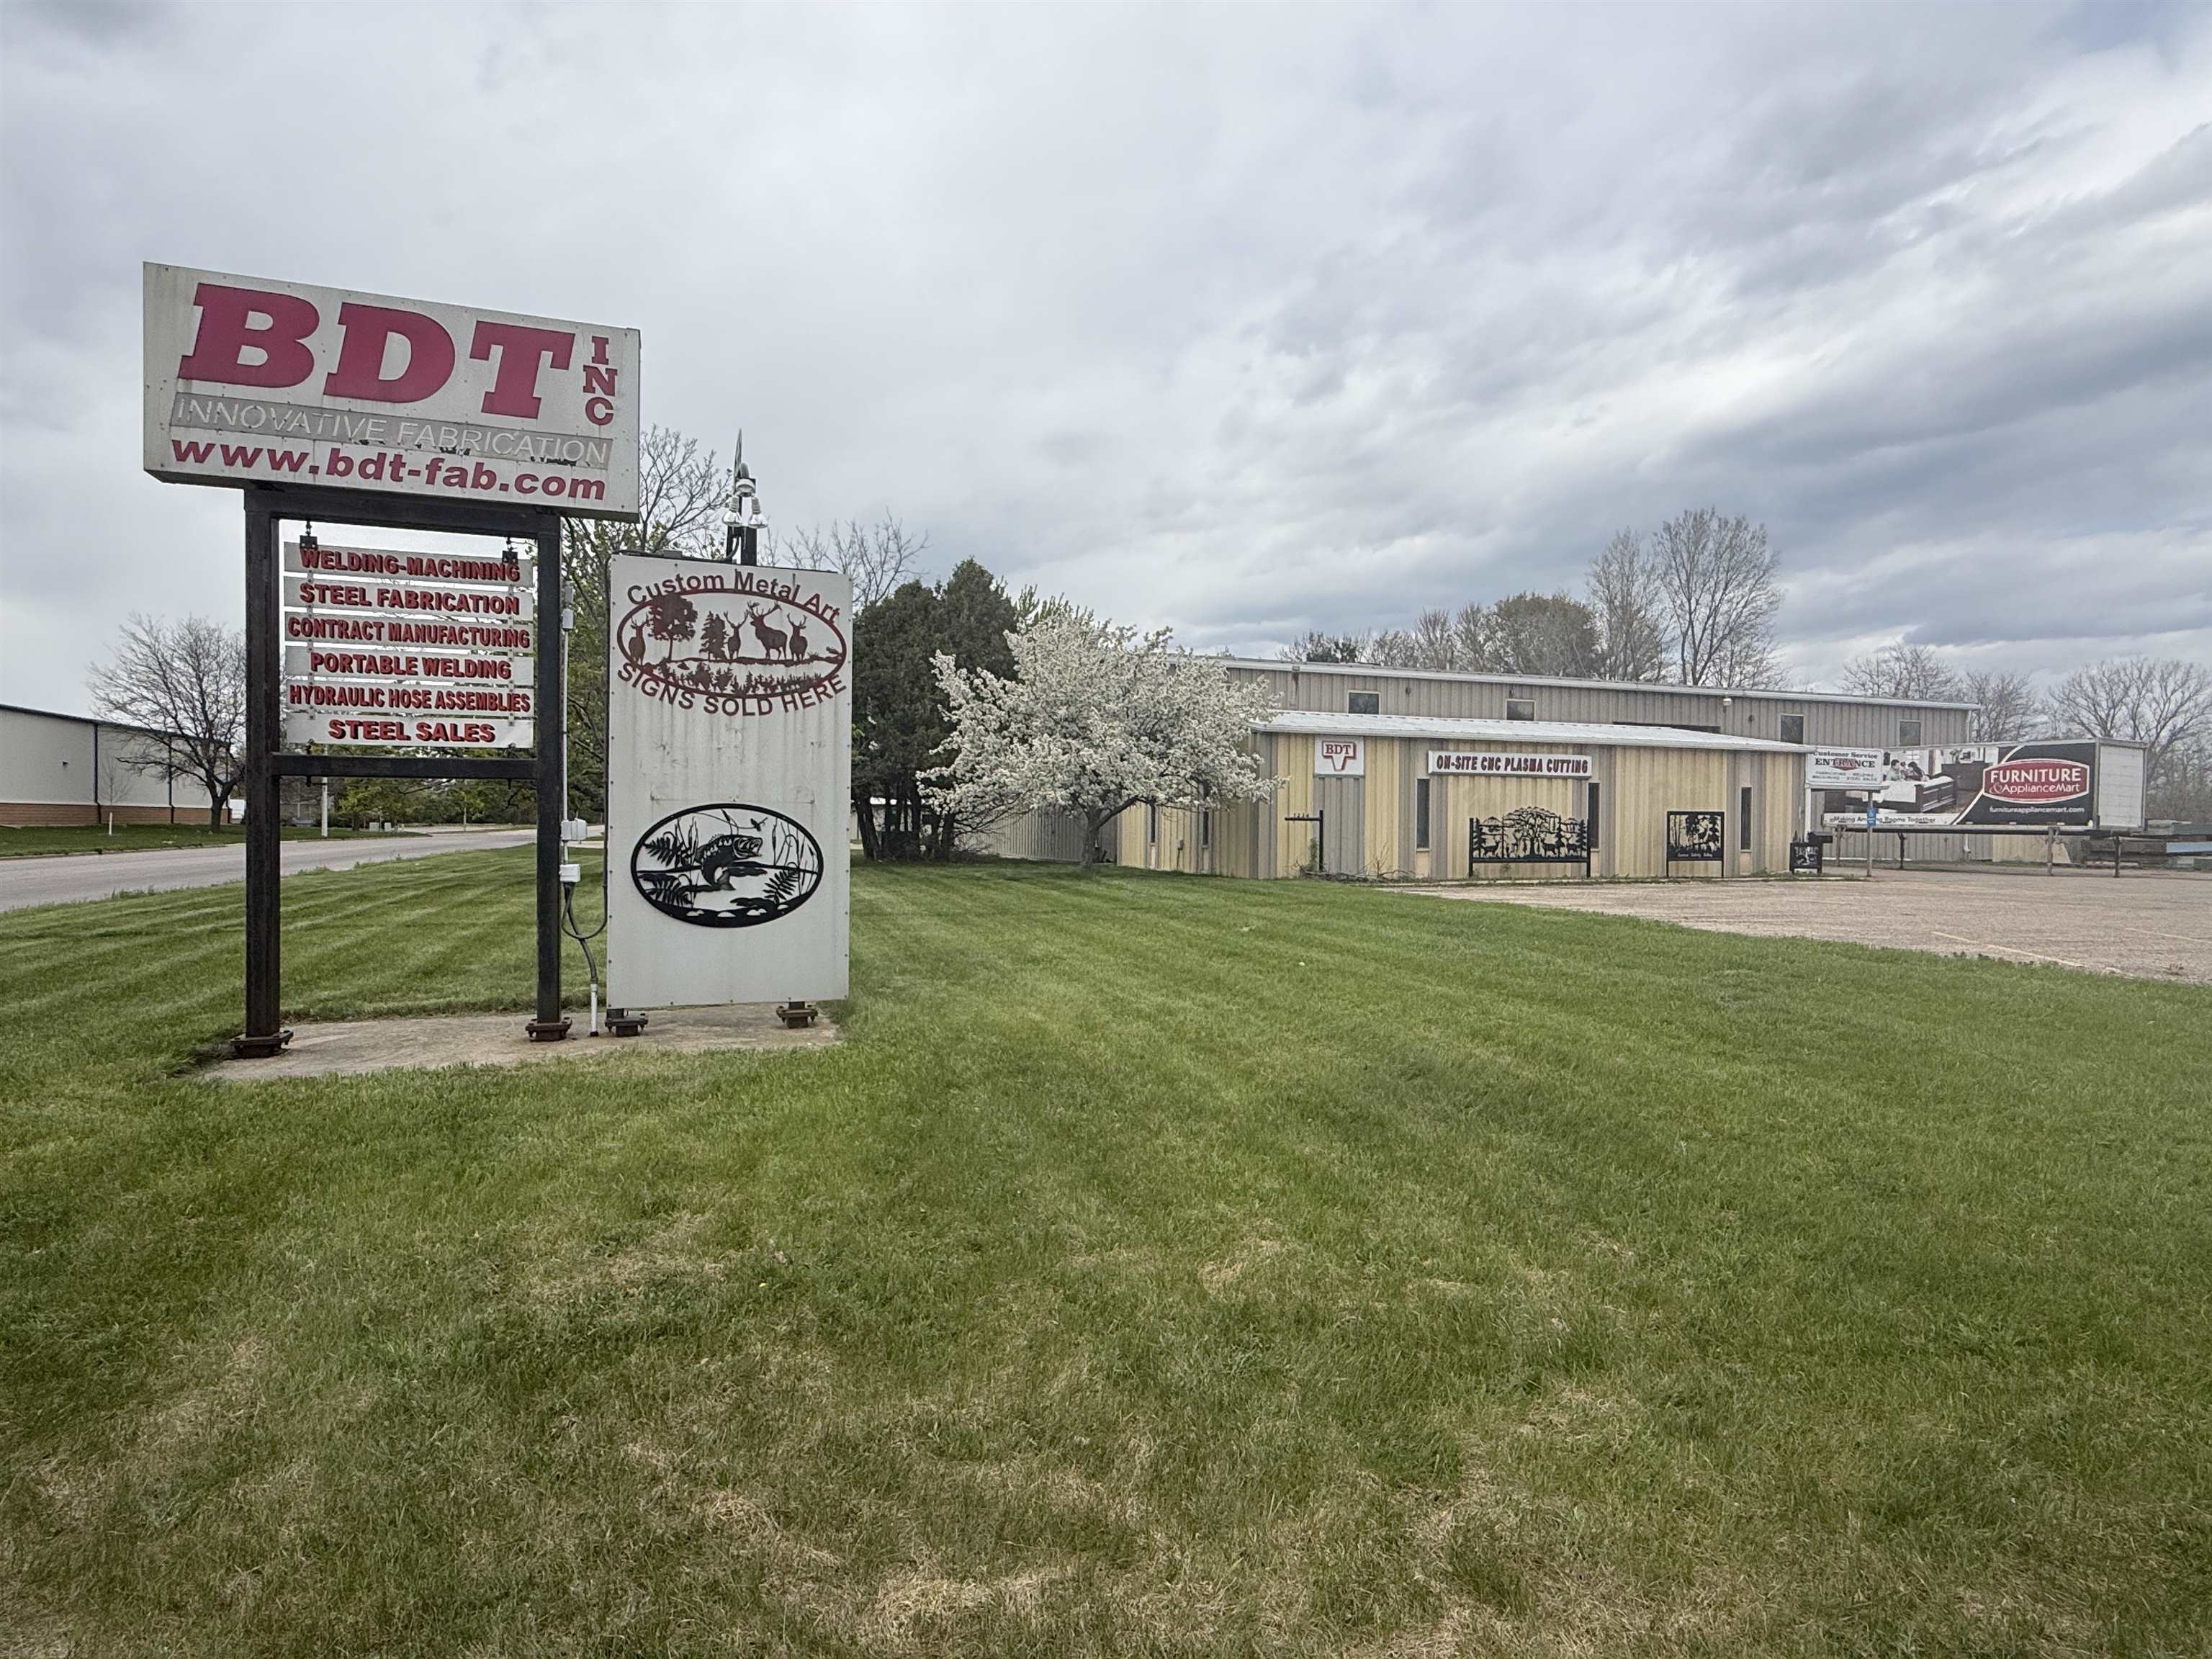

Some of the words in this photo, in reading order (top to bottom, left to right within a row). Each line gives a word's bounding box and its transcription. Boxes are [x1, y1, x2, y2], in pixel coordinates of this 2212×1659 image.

[177, 282, 576, 419] BDT
[583, 335, 618, 426] INC
[176, 397, 387, 442] INNOVATIVE
[397, 422, 608, 463] FABRICATION
[171, 439, 606, 501] www.bdt-fab.com
[300, 548, 521, 582] WELDING-MACHINING
[300, 583, 372, 606] STEEL
[377, 588, 520, 615] FABRICATION
[627, 573, 725, 605] Custom
[733, 569, 801, 603] Metal
[802, 593, 842, 624] Art
[288, 617, 385, 642] CONTRACT
[387, 623, 530, 648] MANUFACTURING
[310, 653, 418, 675] PORTABLE
[422, 657, 512, 680] WELDING
[289, 685, 385, 707] HYDRAULIC
[388, 688, 432, 709] HOSE
[434, 691, 531, 712] ASSEMBLIES
[617, 662, 696, 710] SIGNS
[703, 696, 773, 716] SOLD
[781, 675, 848, 714] HERE
[328, 719, 411, 742] STEEL
[415, 722, 496, 743] SALES
[1325, 744, 1351, 755] BDT
[1436, 755, 1478, 771] ON-SITE
[1480, 756, 1501, 772] CNC
[1504, 757, 1543, 773] PLASMA
[1546, 758, 1588, 773] CUTTING
[1815, 757, 1876, 768] ENTRANCE
[1990, 768, 2082, 783] FURNITURE
[1989, 806, 2085, 814] furnitureappliancemart.com
